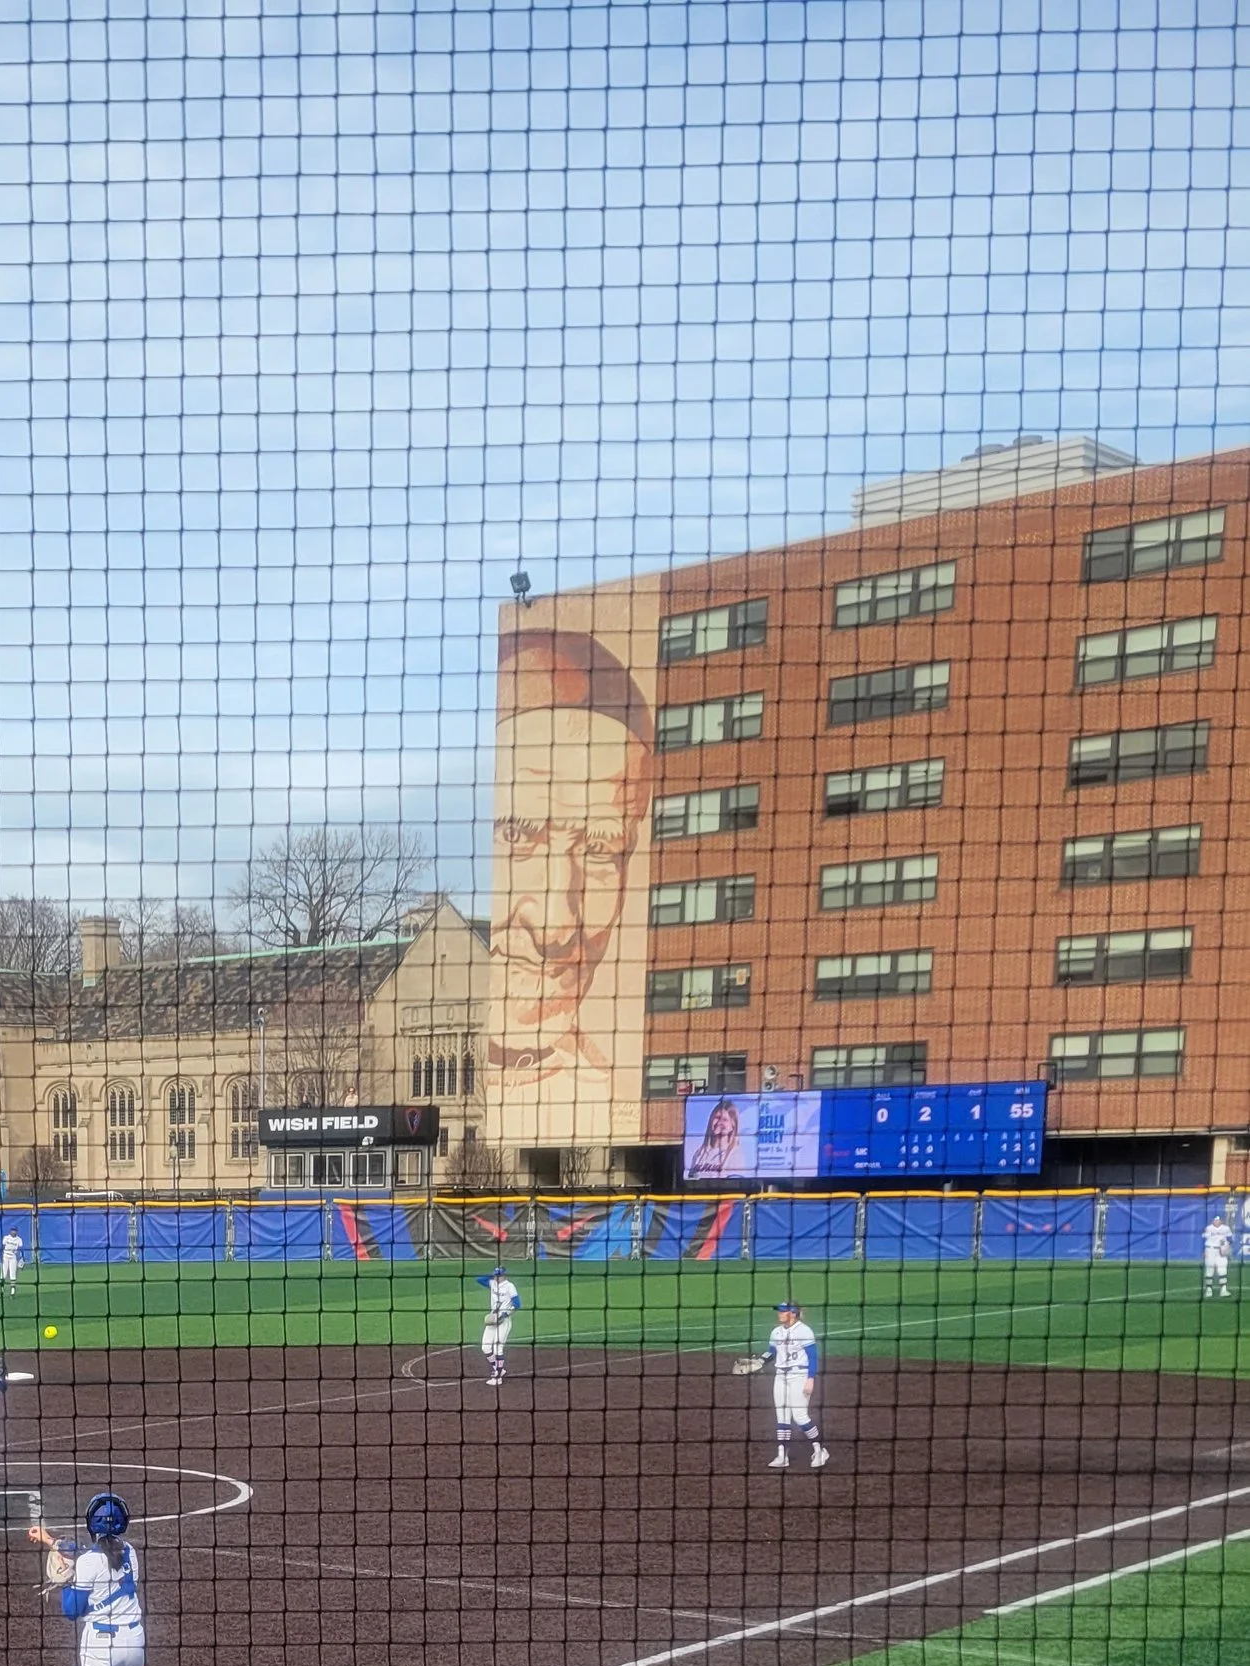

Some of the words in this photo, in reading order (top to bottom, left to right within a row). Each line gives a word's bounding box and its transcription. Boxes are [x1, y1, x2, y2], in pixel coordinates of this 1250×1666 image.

[876, 1107, 889, 1123] 0
[917, 1106, 932, 1122] 2
[970, 1104, 981, 1120] 1
[1009, 1103, 1034, 1119] 55
[268, 1117, 318, 1132] WISH
[322, 1115, 380, 1130] FIELD
[759, 1115, 784, 1129] BELLA
